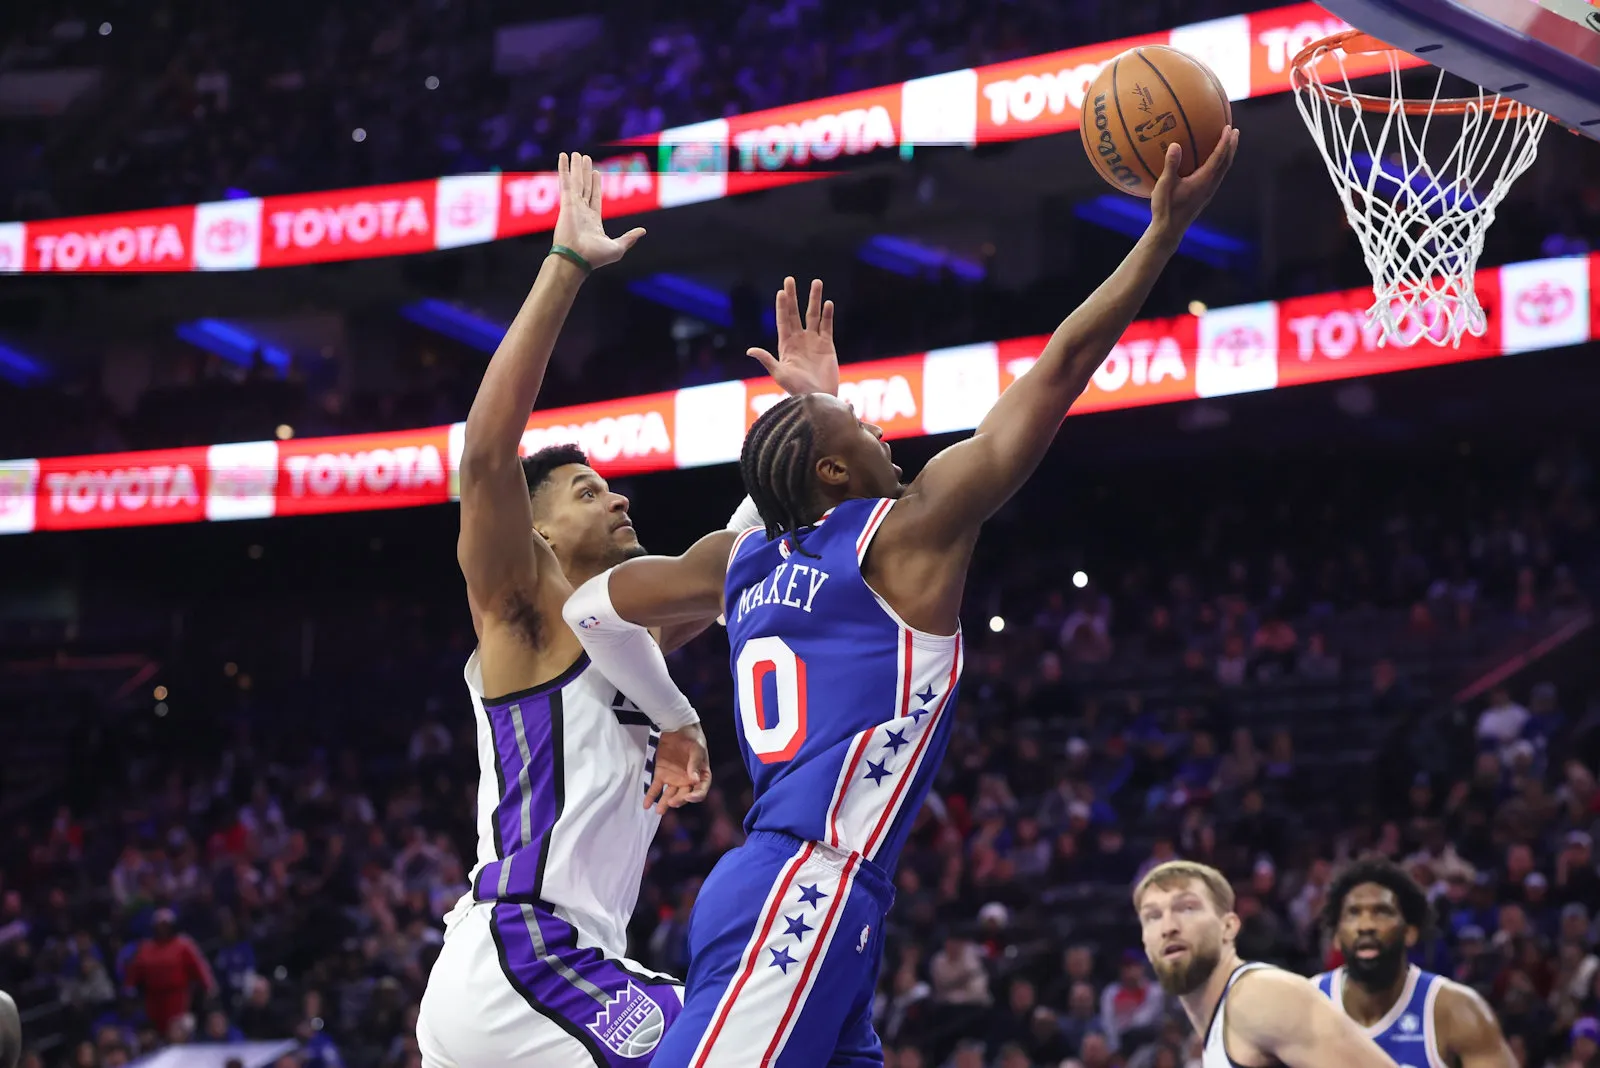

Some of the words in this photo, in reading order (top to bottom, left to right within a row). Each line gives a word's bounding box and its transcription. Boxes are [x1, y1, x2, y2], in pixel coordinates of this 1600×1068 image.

[733, 105, 896, 173] TOYOTA
[1094, 91, 1142, 187] Wilson
[505, 152, 653, 217] TOTA
[34, 224, 185, 270] TOYOTA
[270, 197, 429, 249] TOYOTA
[46, 464, 198, 514] TOYOTA
[284, 445, 445, 497] TOYOTA
[737, 562, 830, 623] MAXEY
[736, 636, 807, 764] 0
[602, 995, 644, 1039] SACRAMENTO
[608, 999, 656, 1051] KINGS
